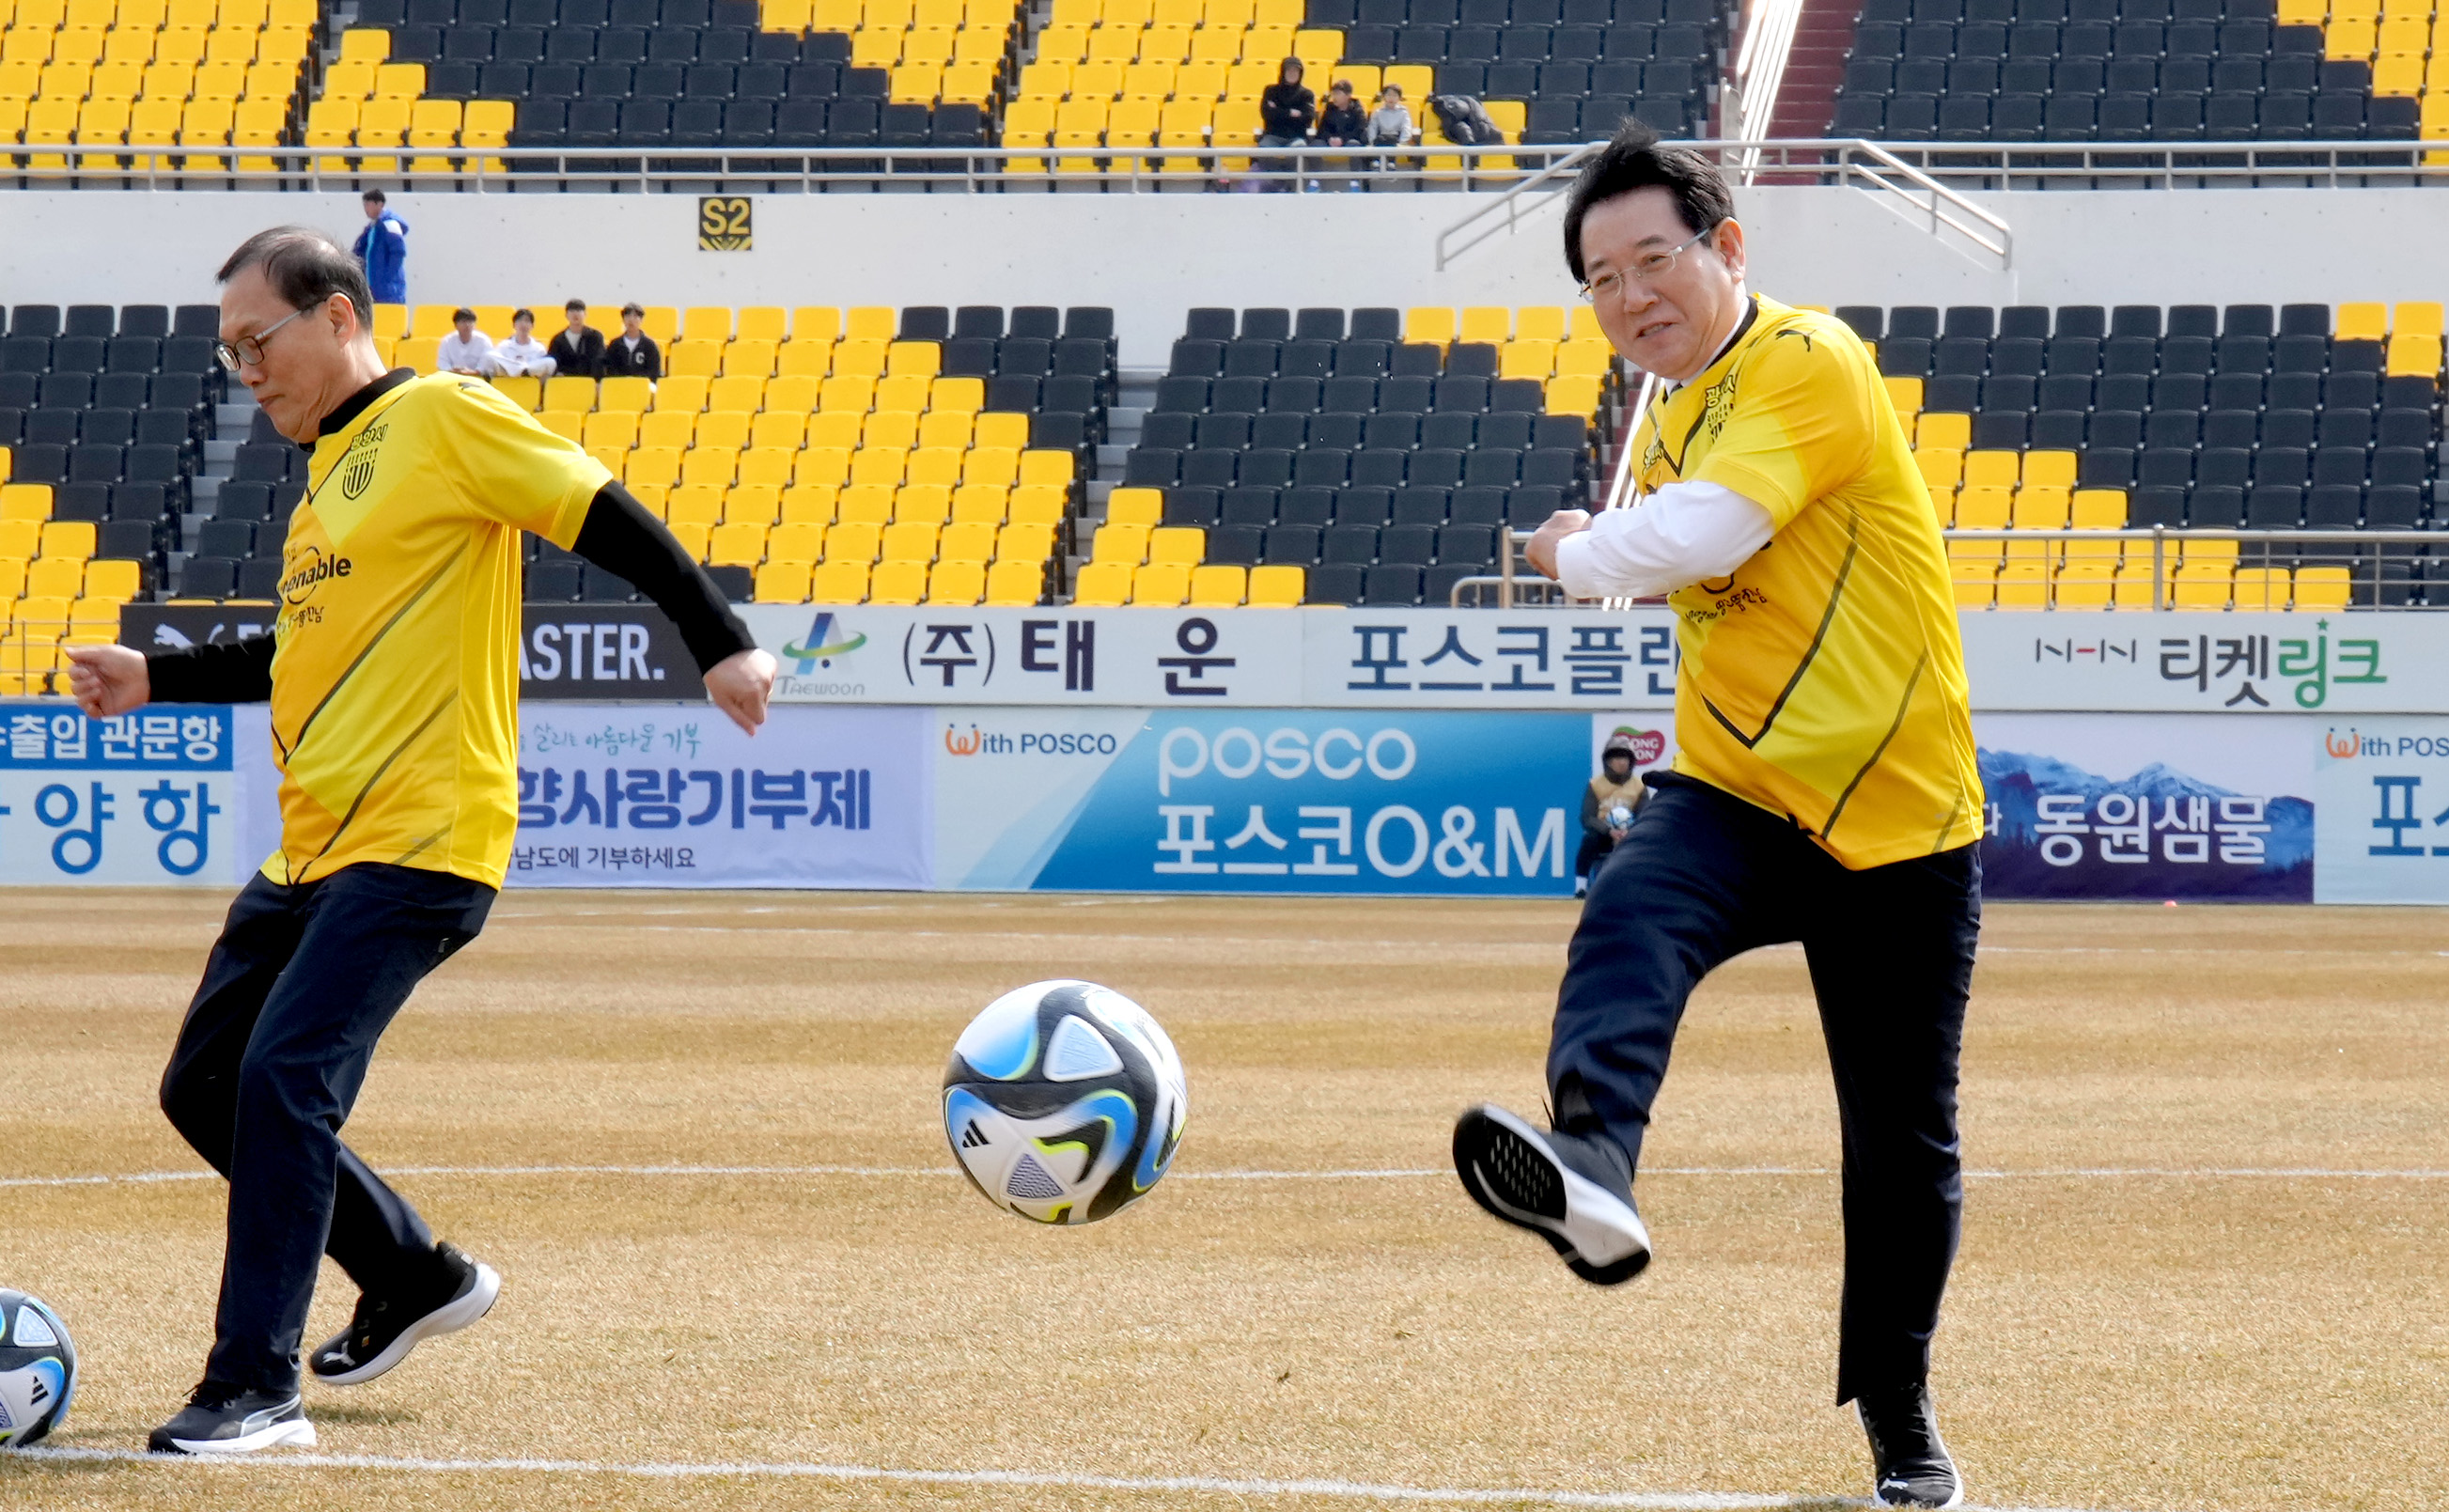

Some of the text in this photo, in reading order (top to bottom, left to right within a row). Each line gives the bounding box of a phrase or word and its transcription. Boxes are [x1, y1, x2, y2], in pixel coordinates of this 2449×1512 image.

[702, 198, 750, 235] S2
[2160, 617, 2388, 709] 티켓링크
[0, 714, 222, 762] 출입 관문항
[585, 723, 656, 756] 아름다운
[663, 723, 702, 759] 기부
[1021, 734, 1116, 755] POSCO
[1159, 727, 1417, 797] posco
[1630, 738, 1660, 749] ONG
[0, 779, 221, 876] 양항
[1153, 804, 1566, 878] 포스코O&M
[2034, 794, 2271, 866] 동원샘물
[510, 847, 696, 871] 남도에 기부하세요
